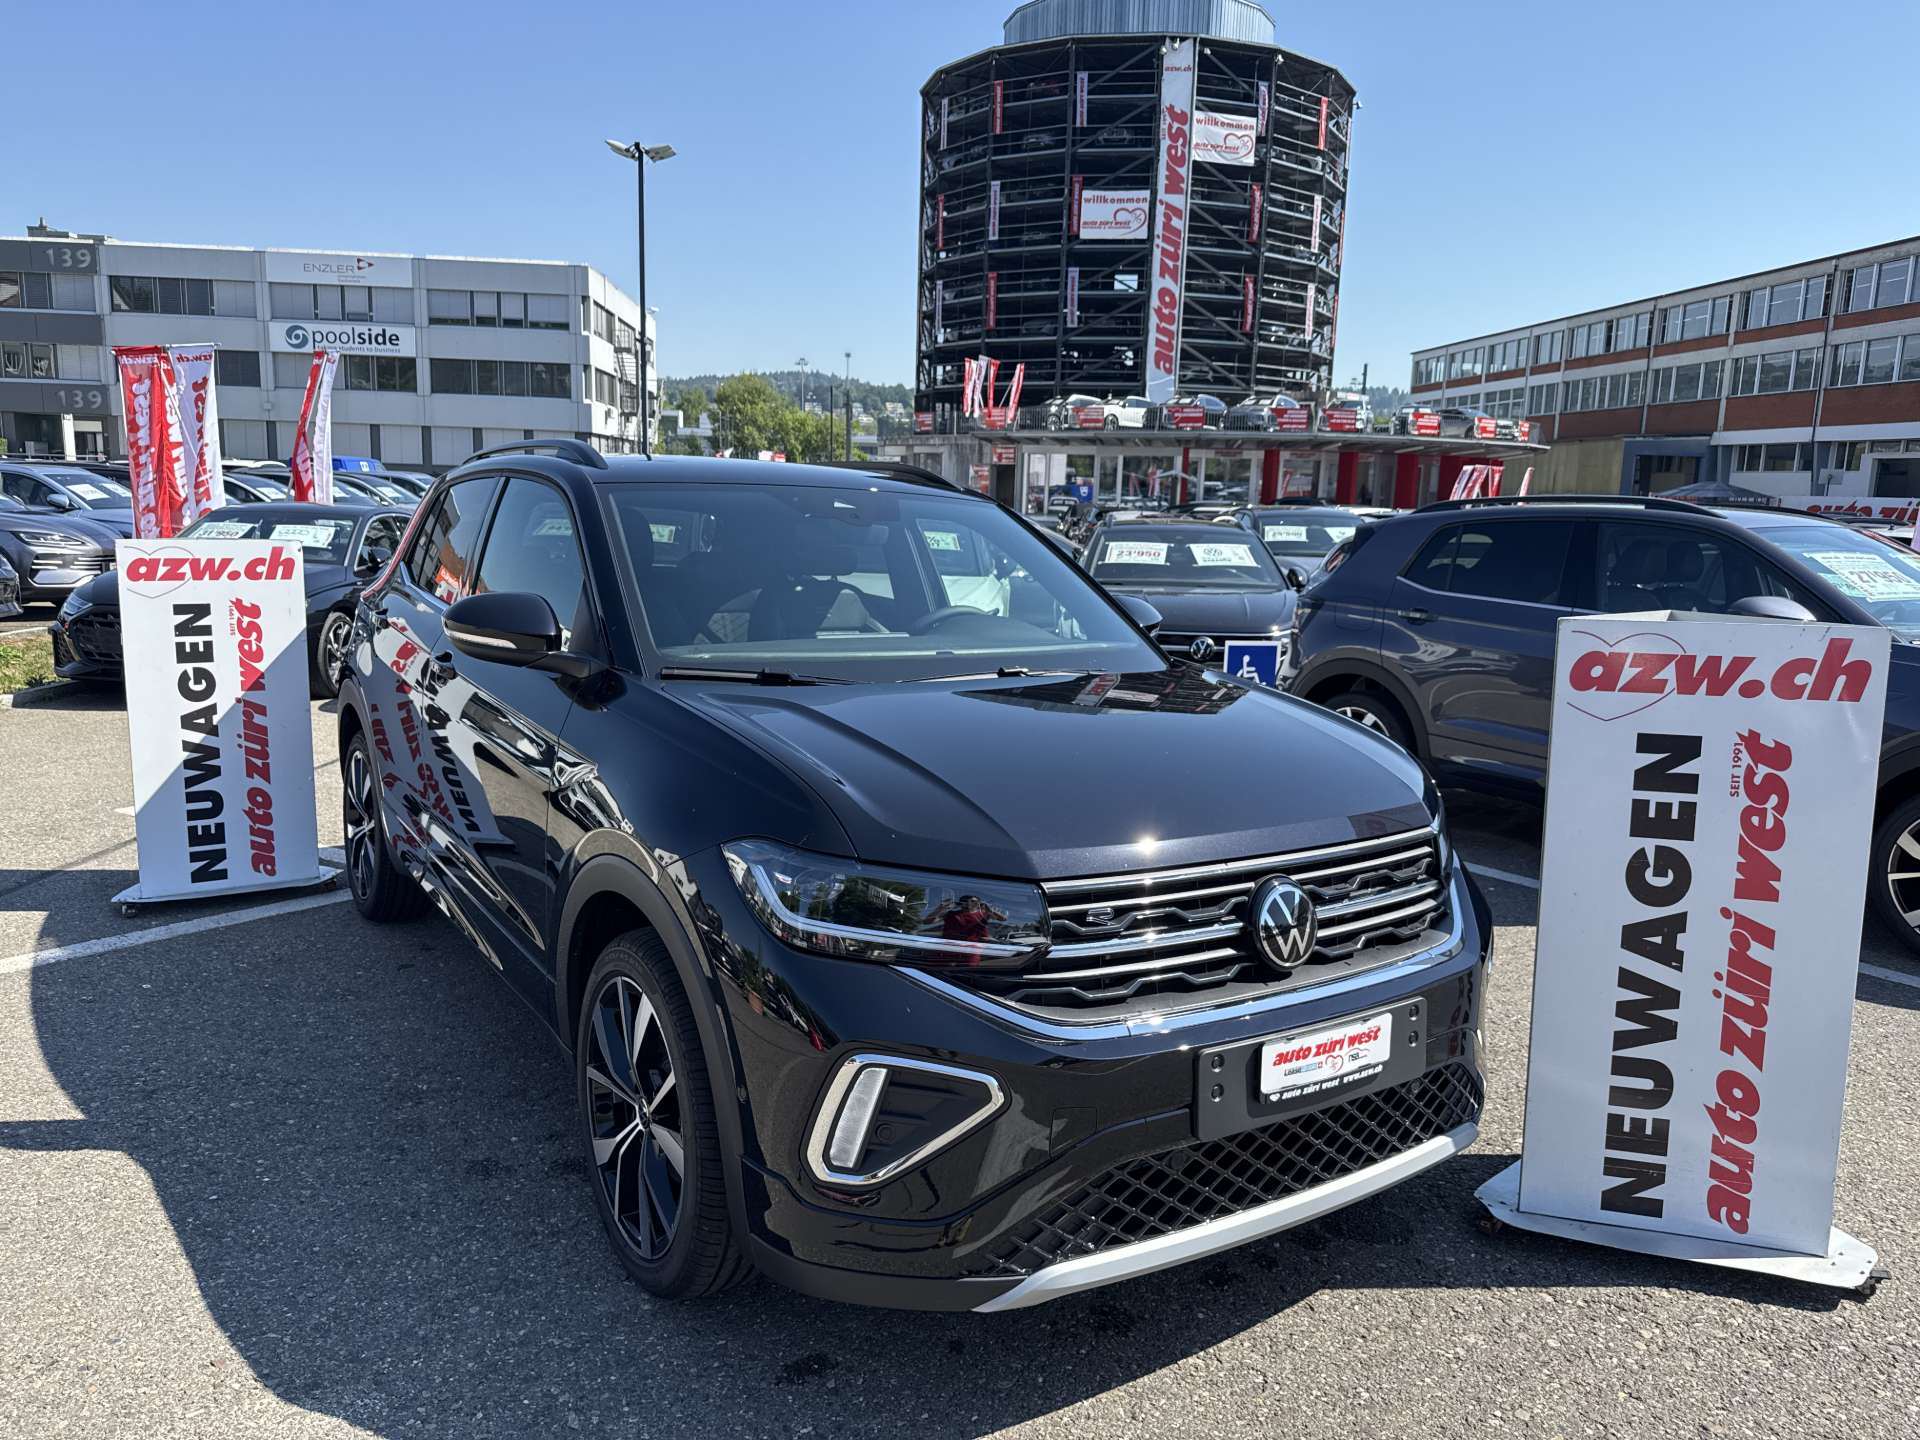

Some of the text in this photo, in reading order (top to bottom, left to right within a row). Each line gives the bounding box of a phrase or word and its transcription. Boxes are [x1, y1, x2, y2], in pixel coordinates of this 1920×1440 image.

[1195, 116, 1255, 131] willkommen
[1083, 194, 1148, 204] willkommen
[1153, 103, 1190, 376] auto züri west
[45, 248, 92, 268] 139
[303, 262, 355, 274] ENZLER
[312, 326, 400, 349] poolside
[56, 389, 103, 409] 139
[126, 546, 296, 582] azw.ch
[1116, 549, 1161, 559] 23'950
[1568, 637, 1873, 703] azw.ch
[172, 602, 229, 884] NEUWAGEN
[229, 597, 278, 878] auto züri west
[1729, 740, 1745, 798] SEIT 1991
[1599, 731, 1704, 1220] NEUWAGEN
[1702, 728, 1794, 1236] auto züri west
[1272, 1025, 1381, 1067] auto züri west
[1281, 1088, 1301, 1101] auto
[1302, 1081, 1321, 1096] züri
[1321, 1078, 1340, 1092] west
